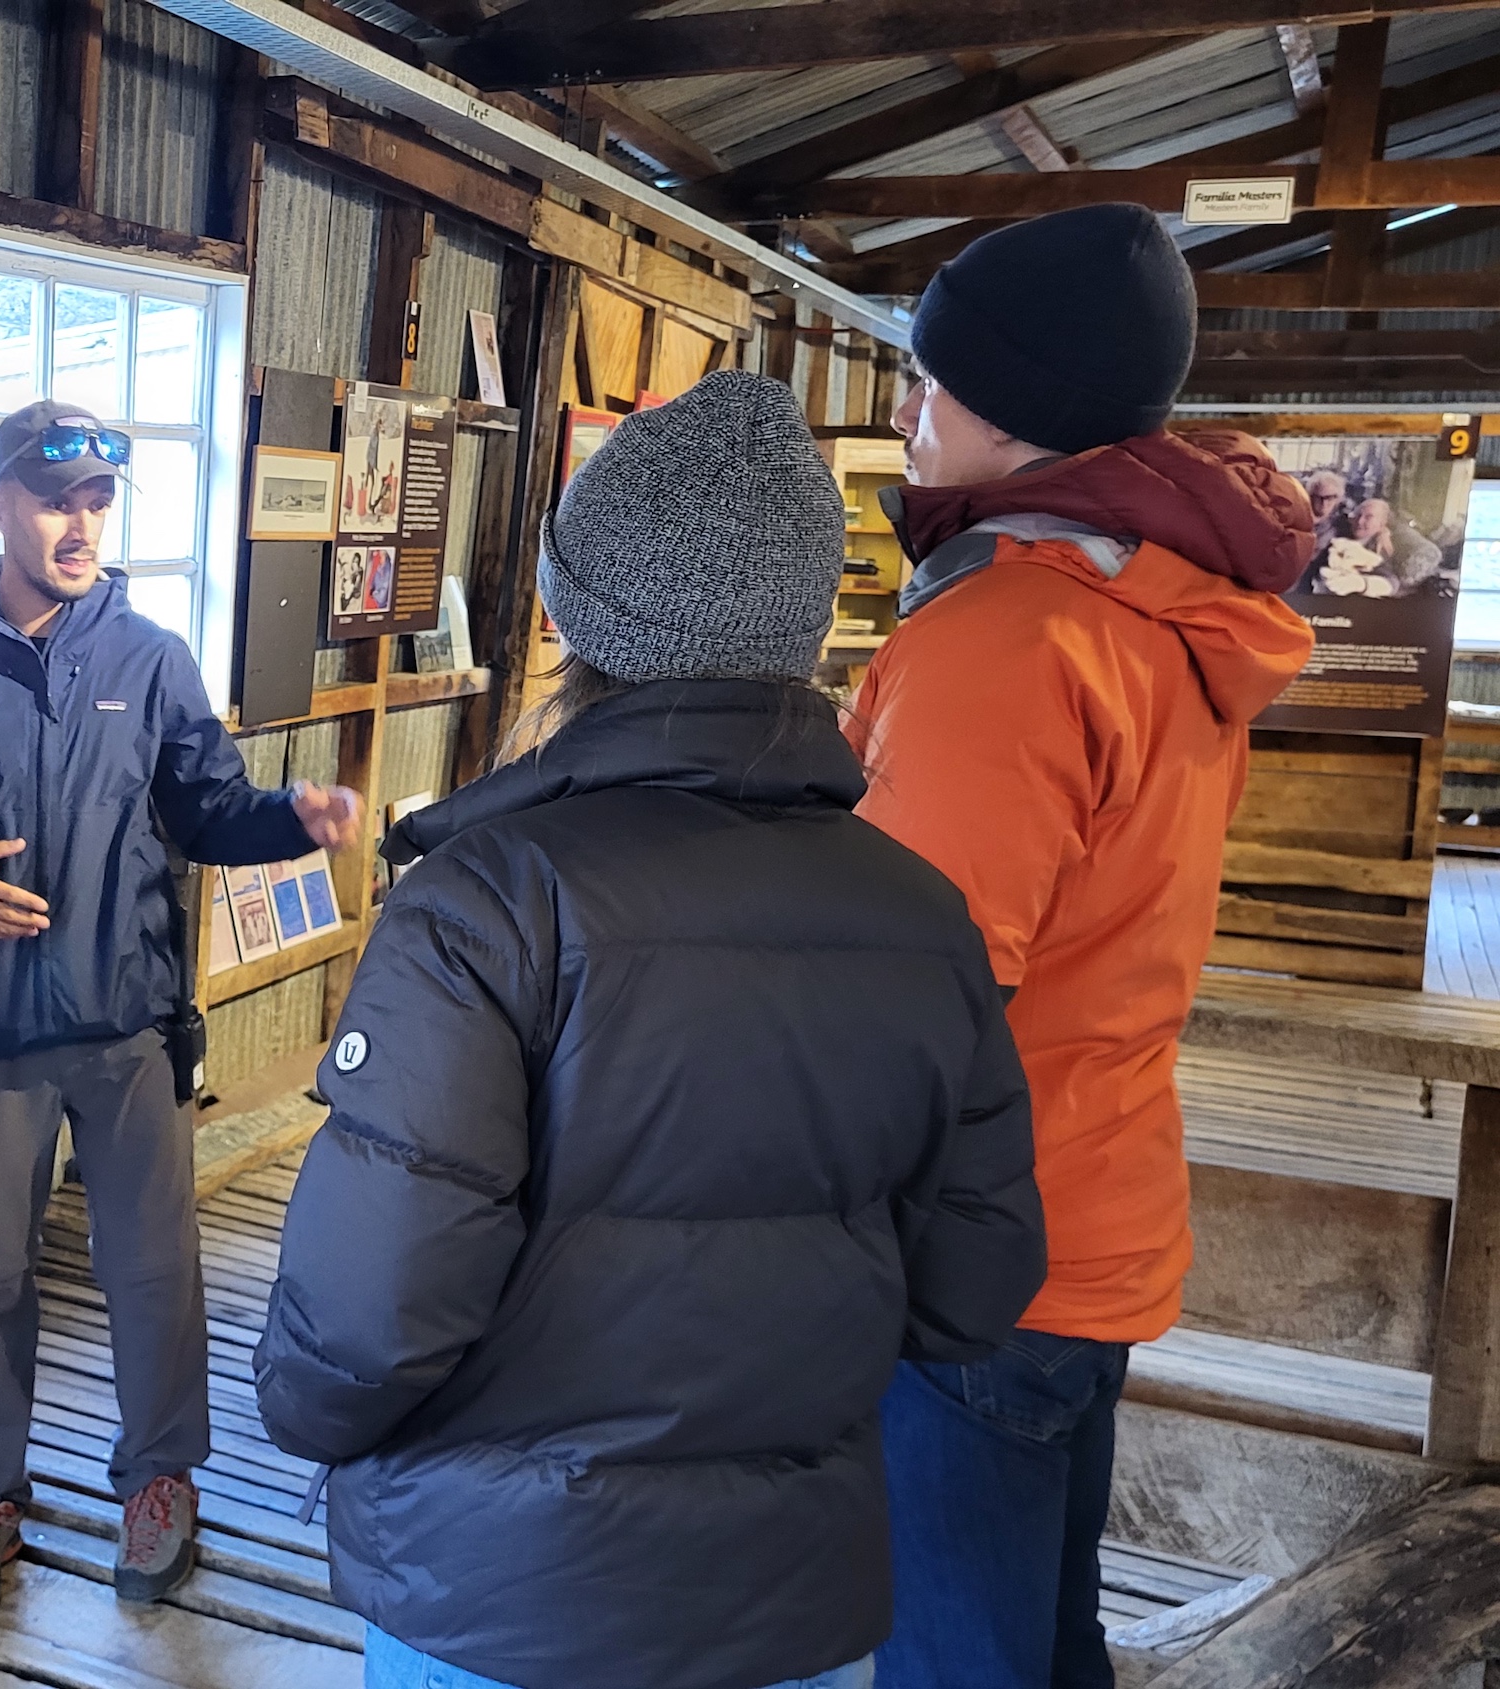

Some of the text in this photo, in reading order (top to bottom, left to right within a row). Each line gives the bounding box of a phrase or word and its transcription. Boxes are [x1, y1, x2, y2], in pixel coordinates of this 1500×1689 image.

[1194, 191, 1282, 202] Familia Masters
[407, 323, 416, 354] 8
[1450, 430, 1470, 456] 9
